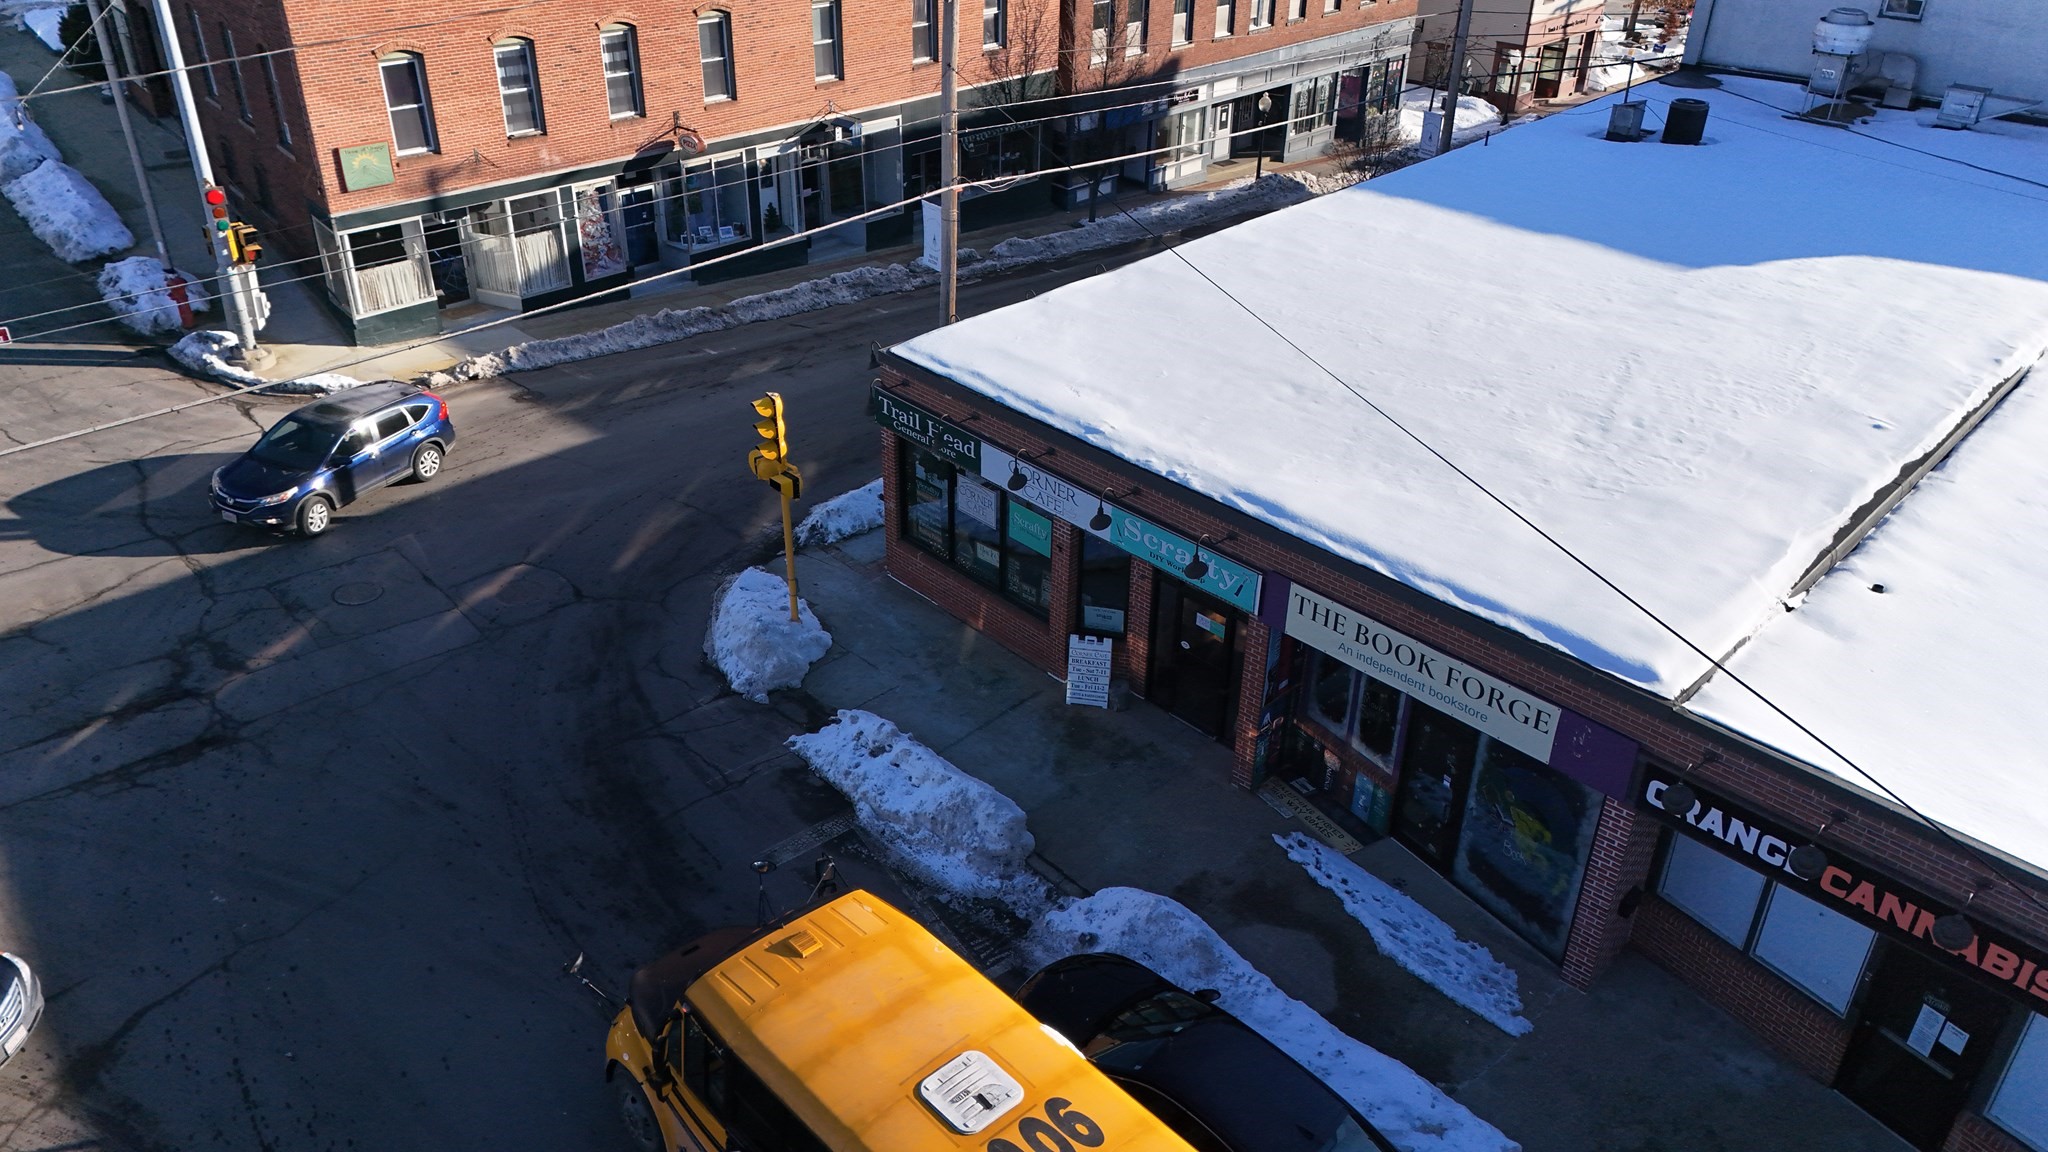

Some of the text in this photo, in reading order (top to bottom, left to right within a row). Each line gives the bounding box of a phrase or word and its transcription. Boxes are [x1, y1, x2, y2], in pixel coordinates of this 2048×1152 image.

[878, 395, 921, 431] Trail
[893, 420, 930, 445] General
[1149, 551, 1164, 562] DIY
[1071, 658, 1107, 667] BREAKFAST
[1294, 592, 1552, 735] THE BOOK FORGE
[1338, 642, 1489, 723] An independent bookstore
[1286, 799, 1306, 815] WAY
[1304, 815, 1334, 839] COMES
[987, 1097, 1105, 1152] 06
